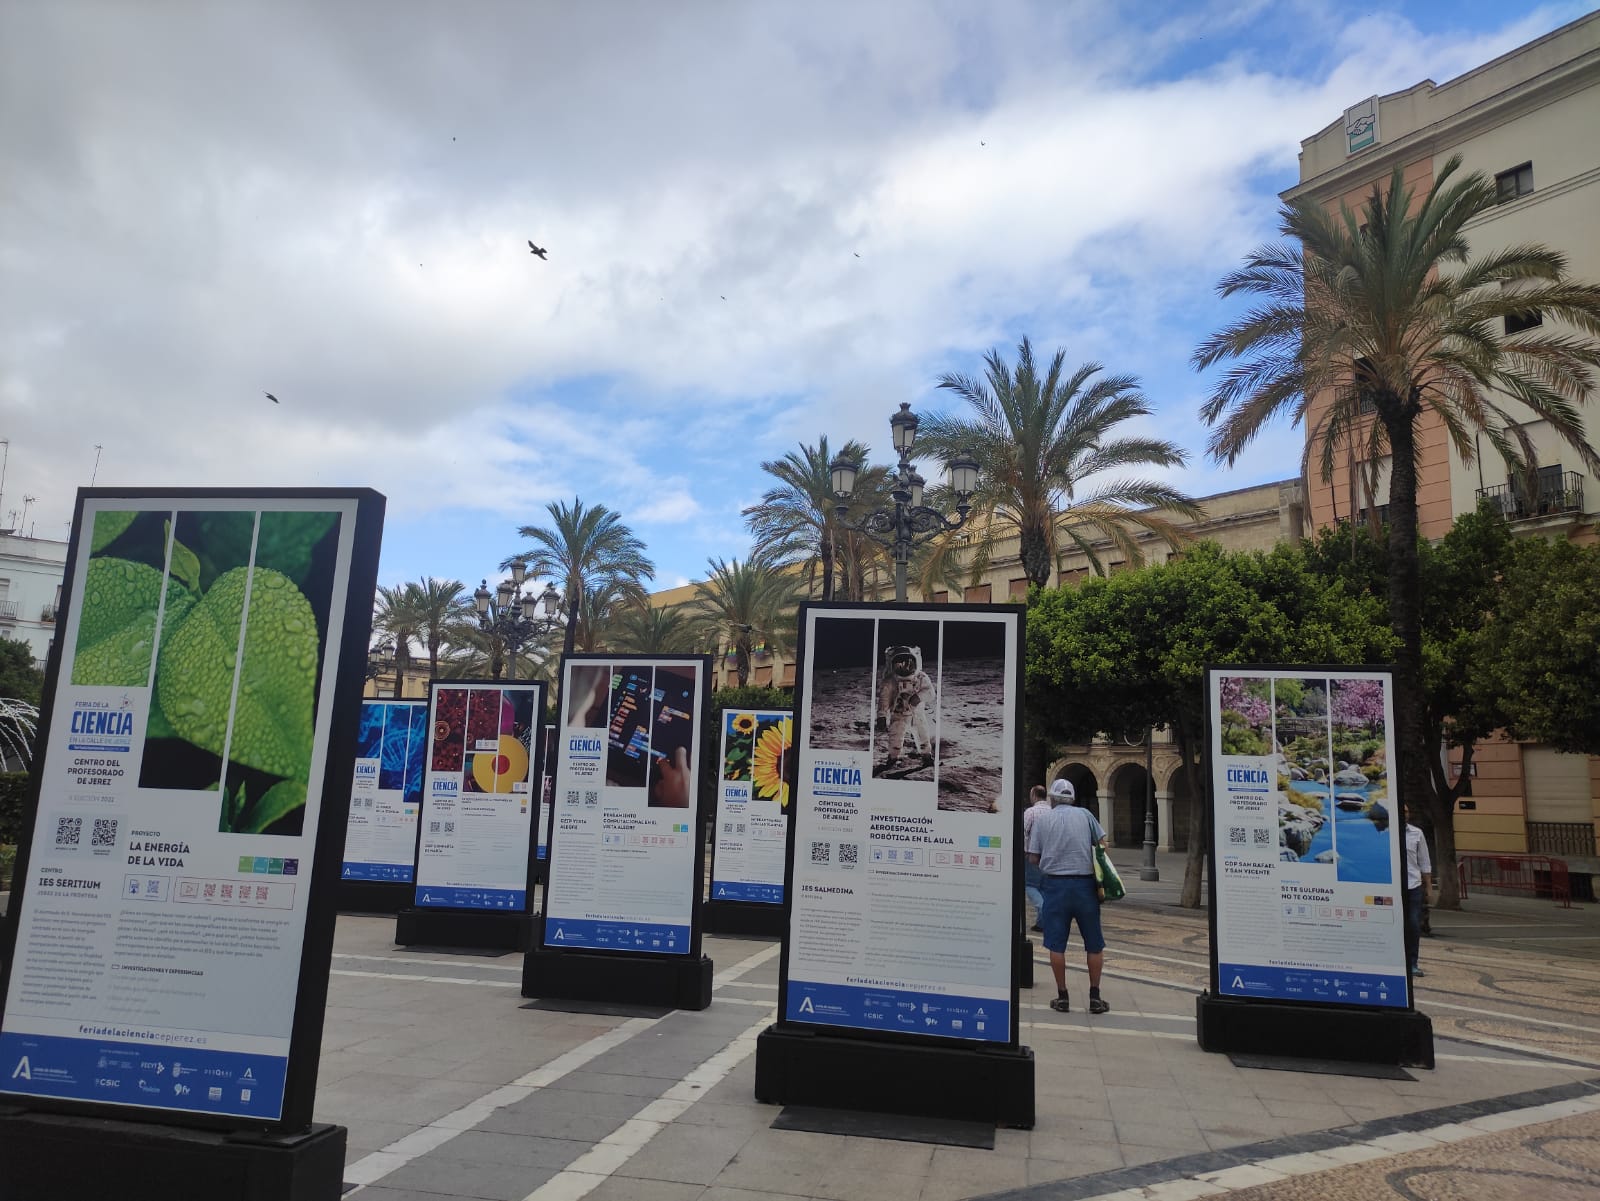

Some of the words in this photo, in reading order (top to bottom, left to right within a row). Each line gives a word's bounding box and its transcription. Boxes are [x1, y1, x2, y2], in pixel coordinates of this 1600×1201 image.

[71, 710, 133, 735] CIENCIA
[569, 739, 602, 752] CIENCIA
[74, 758, 105, 767] CENTRO
[106, 759, 120, 767] DEL
[67, 767, 124, 777] PROFESORADO
[813, 767, 862, 786] CIENCIA
[1227, 769, 1269, 784] CIENCIA
[88, 777, 112, 786] JEREZ
[432, 781, 458, 791] CIENCIA
[870, 814, 933, 825] INVESTIGACIÓN
[870, 824, 928, 834] AEROESPACIAL
[870, 832, 910, 842] ROBÓTICA
[934, 837, 955, 845] AULA
[129, 841, 142, 852] LA
[144, 841, 191, 854] ENERGÍA
[127, 855, 141, 865] DE
[143, 856, 155, 866] LA
[158, 857, 184, 868] VIDA
[38, 877, 54, 887] IES
[55, 878, 101, 889] SERITIUM
[814, 886, 855, 895] SALMEDINA
[100, 1078, 121, 1088] CSIC
